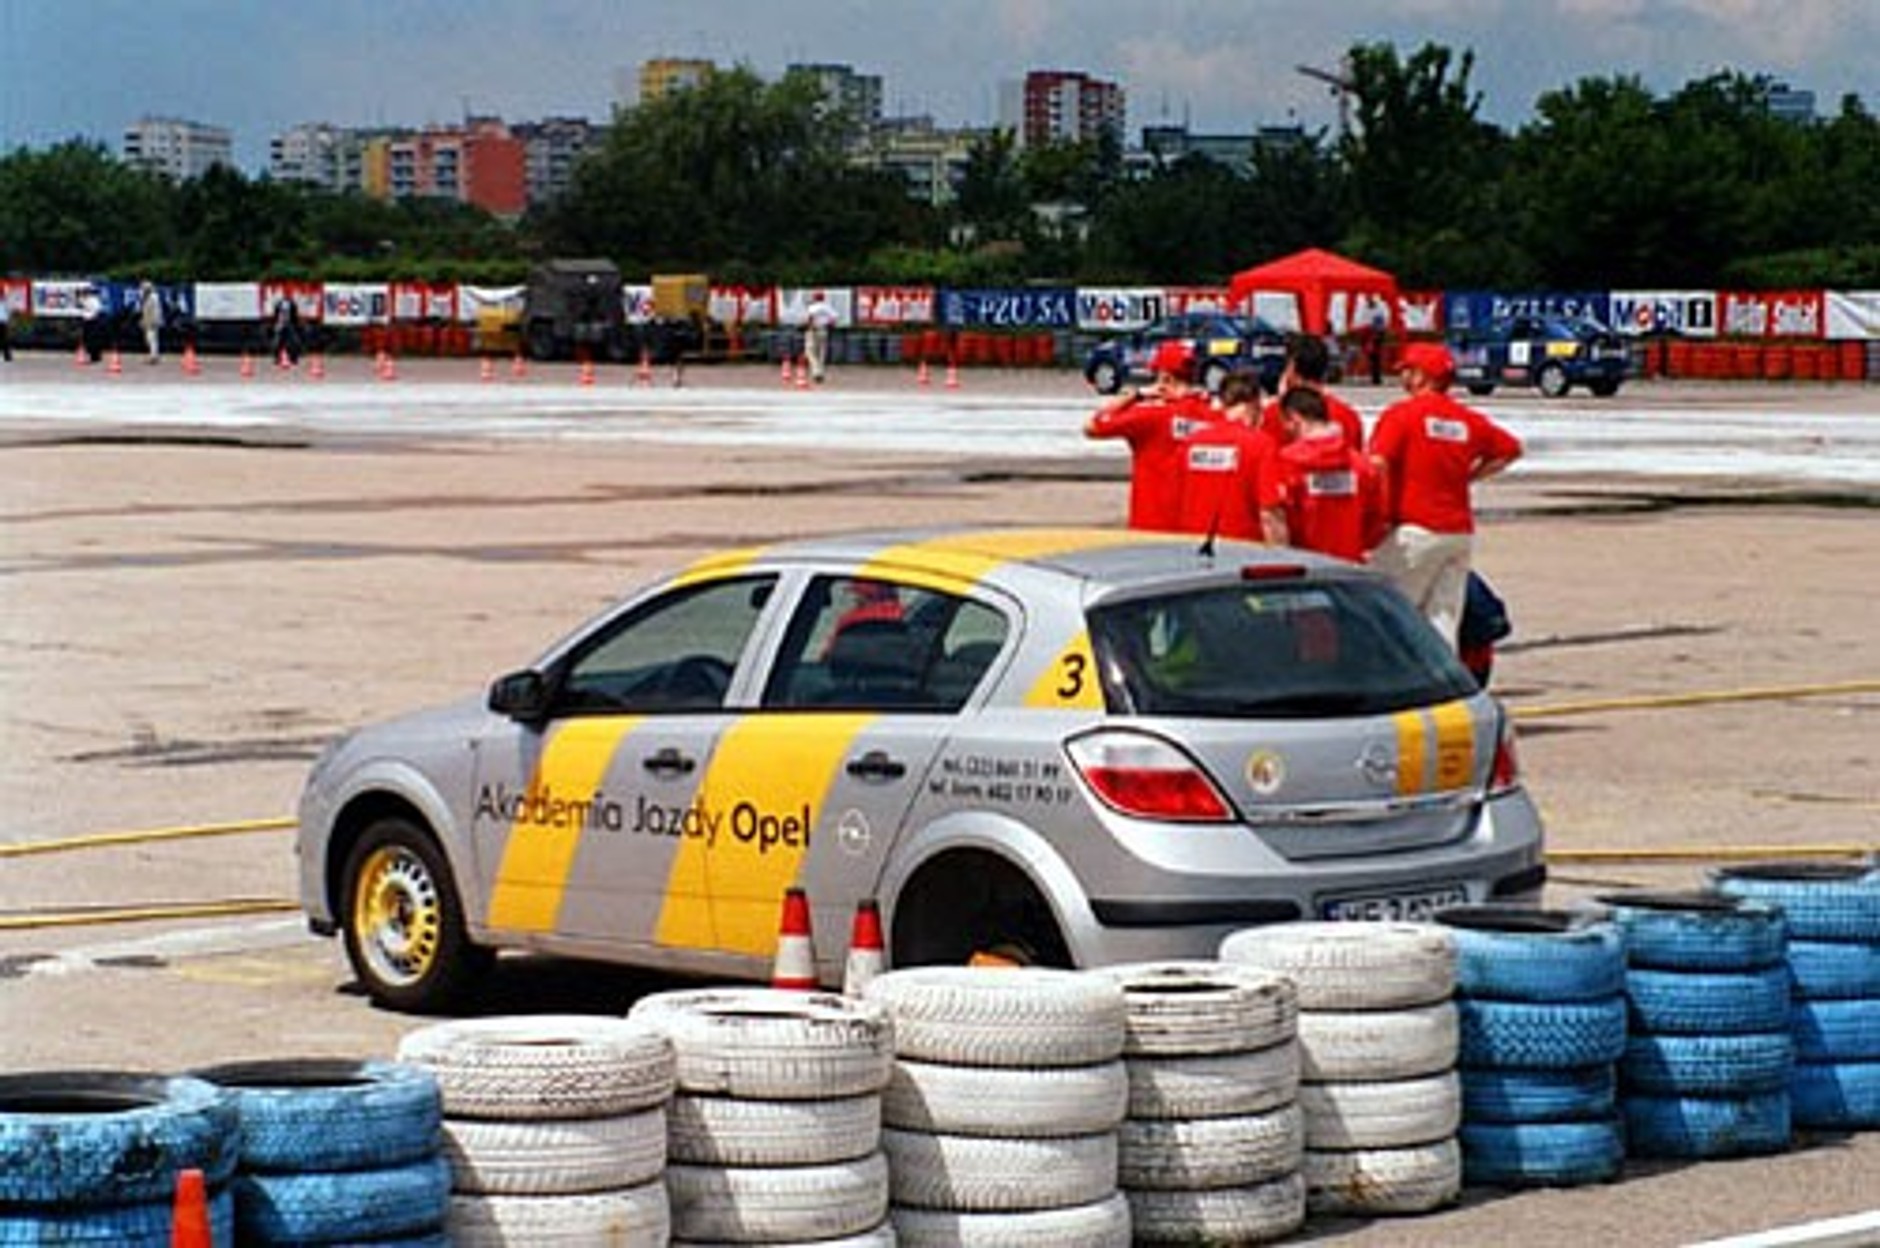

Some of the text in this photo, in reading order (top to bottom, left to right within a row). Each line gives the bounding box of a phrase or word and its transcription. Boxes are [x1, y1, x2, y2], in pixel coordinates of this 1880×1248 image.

[980, 297, 1029, 325] PZU
[1057, 653, 1086, 698] 3
[475, 783, 811, 853] Akademia Jazdy Opel
